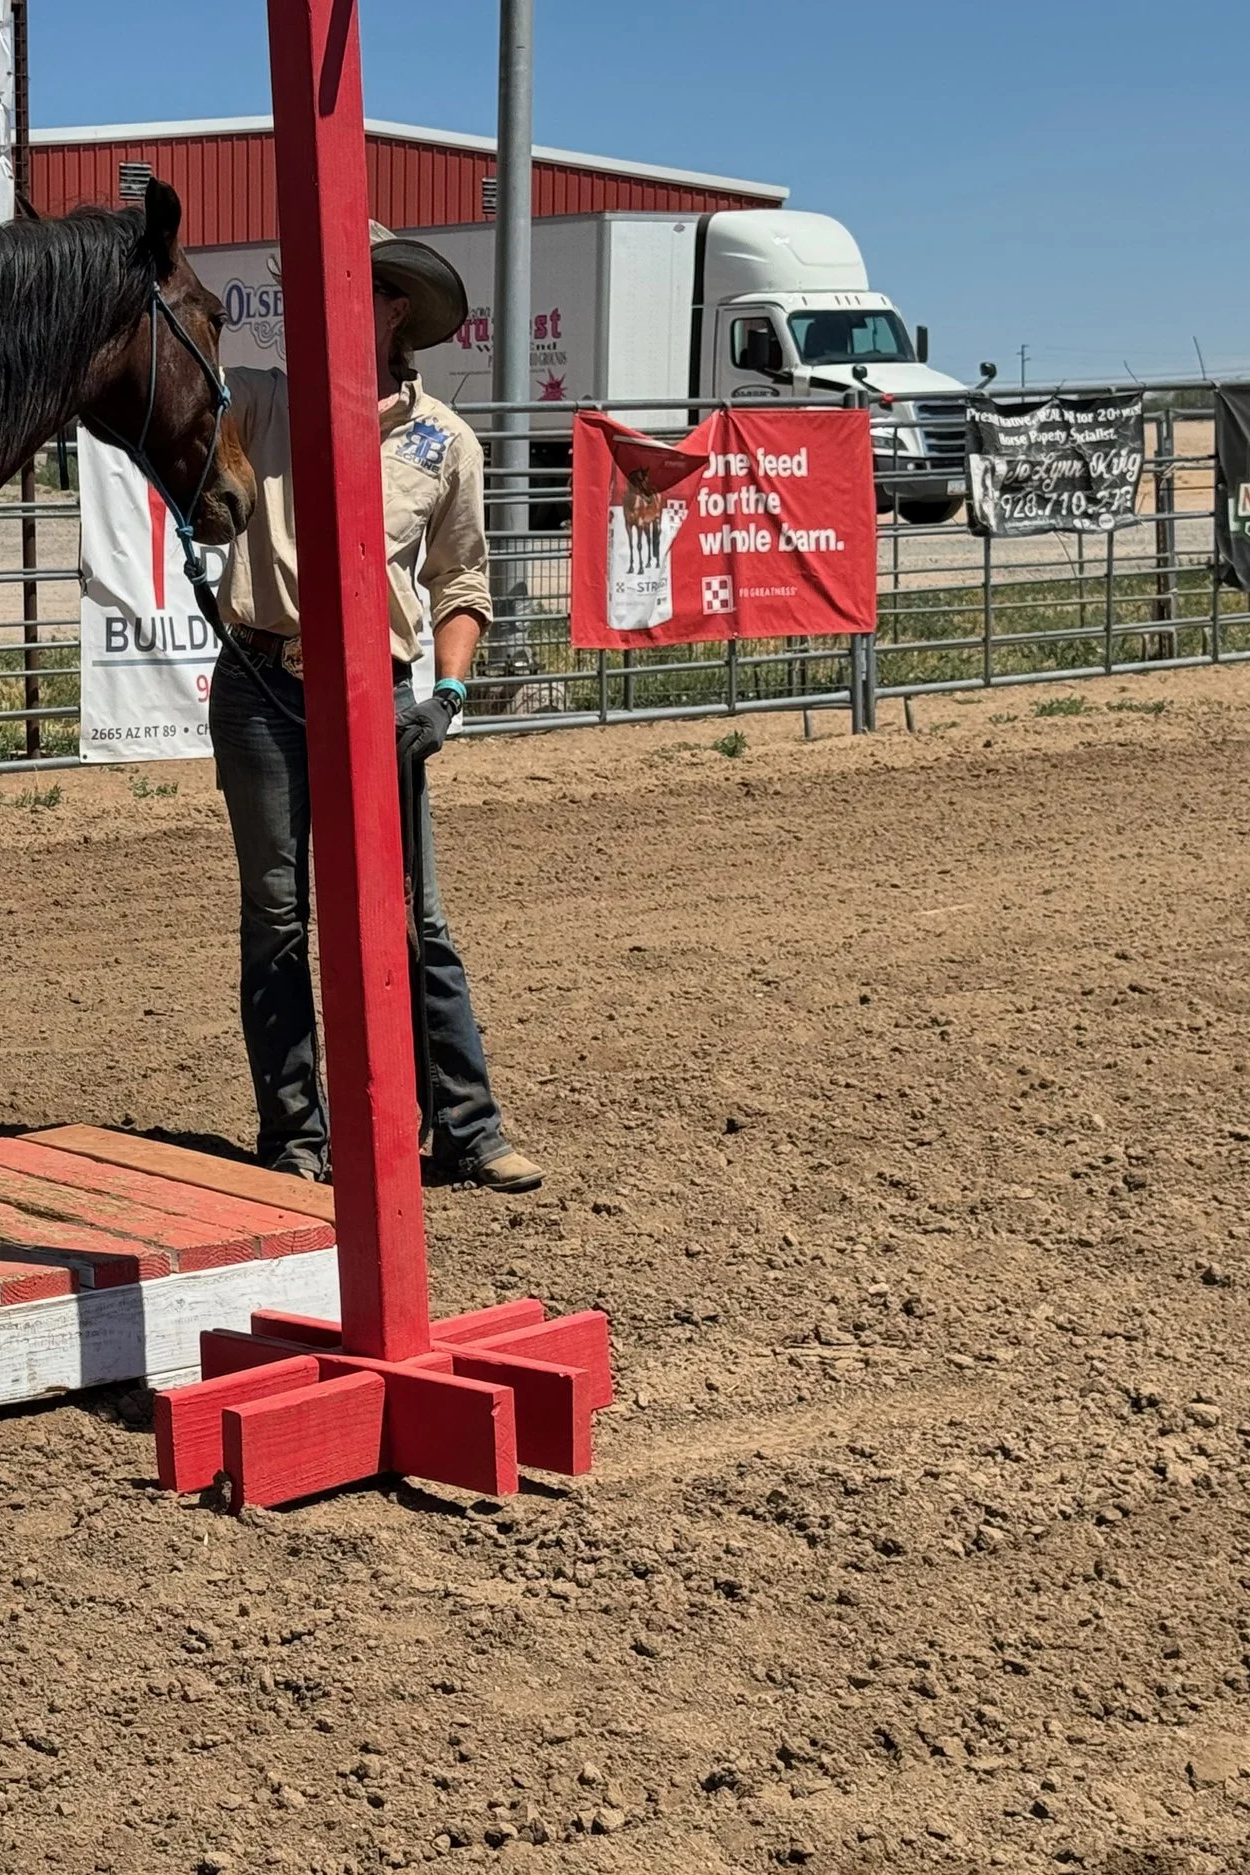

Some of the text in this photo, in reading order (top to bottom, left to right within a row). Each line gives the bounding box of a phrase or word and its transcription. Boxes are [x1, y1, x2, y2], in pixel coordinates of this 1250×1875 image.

[756, 447, 808, 478] feed
[697, 484, 782, 517] for the
[698, 522, 845, 556] whole barn.
[91, 724, 177, 741] 2665 AZ RT 89
